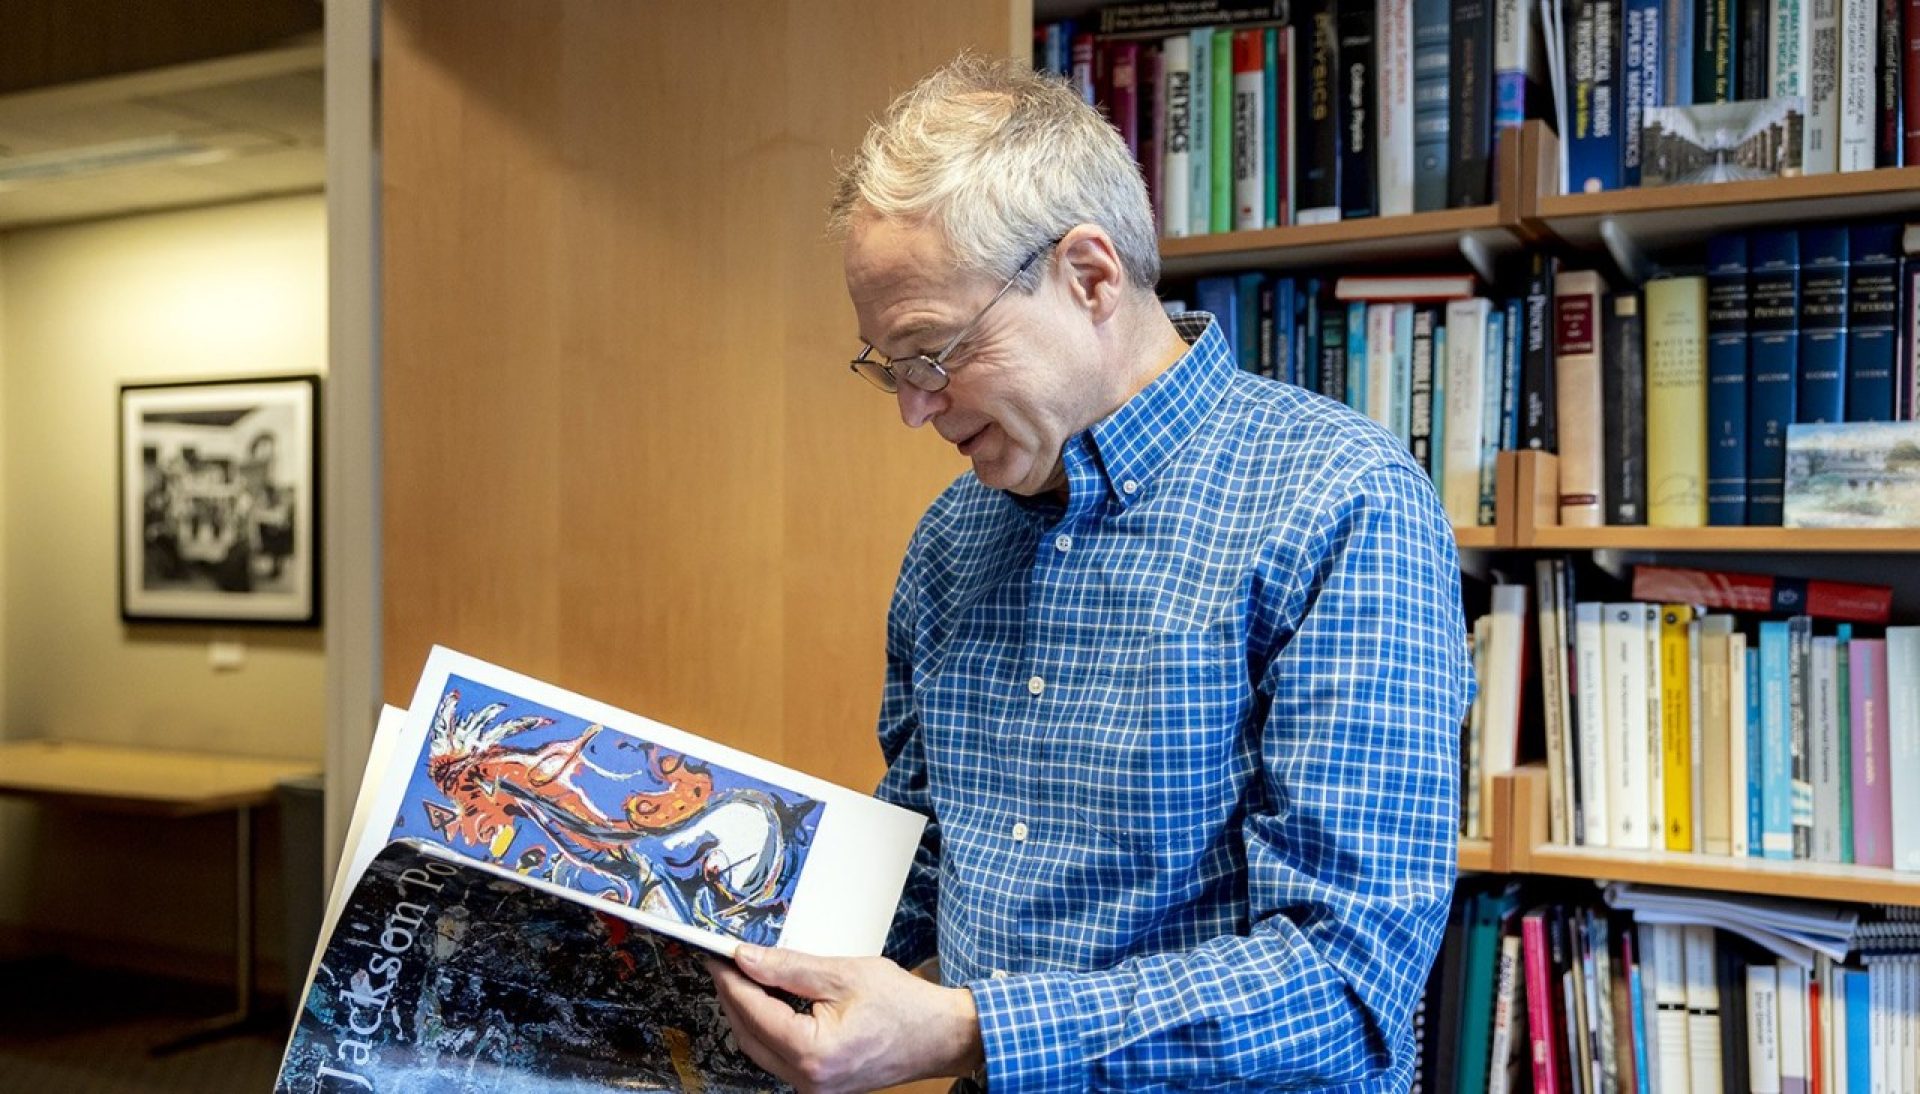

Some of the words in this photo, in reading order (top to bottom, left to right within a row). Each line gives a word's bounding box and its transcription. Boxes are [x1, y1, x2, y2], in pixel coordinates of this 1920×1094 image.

[1312, 13, 1329, 120] PHYSICS
[1594, 2, 1612, 82] MATHEMATICAL
[1627, 10, 1642, 67] APPLIED
[1172, 72, 1191, 154] PHYSICS
[1350, 63, 1365, 108] College
[1593, 86, 1612, 138] METHODS
[1625, 70, 1642, 168] MATHEMATICS
[1237, 93, 1248, 181] PHYSICS
[1350, 109, 1365, 153] Physics
[316, 901, 430, 1092] Jackson
[399, 861, 458, 893] Po
